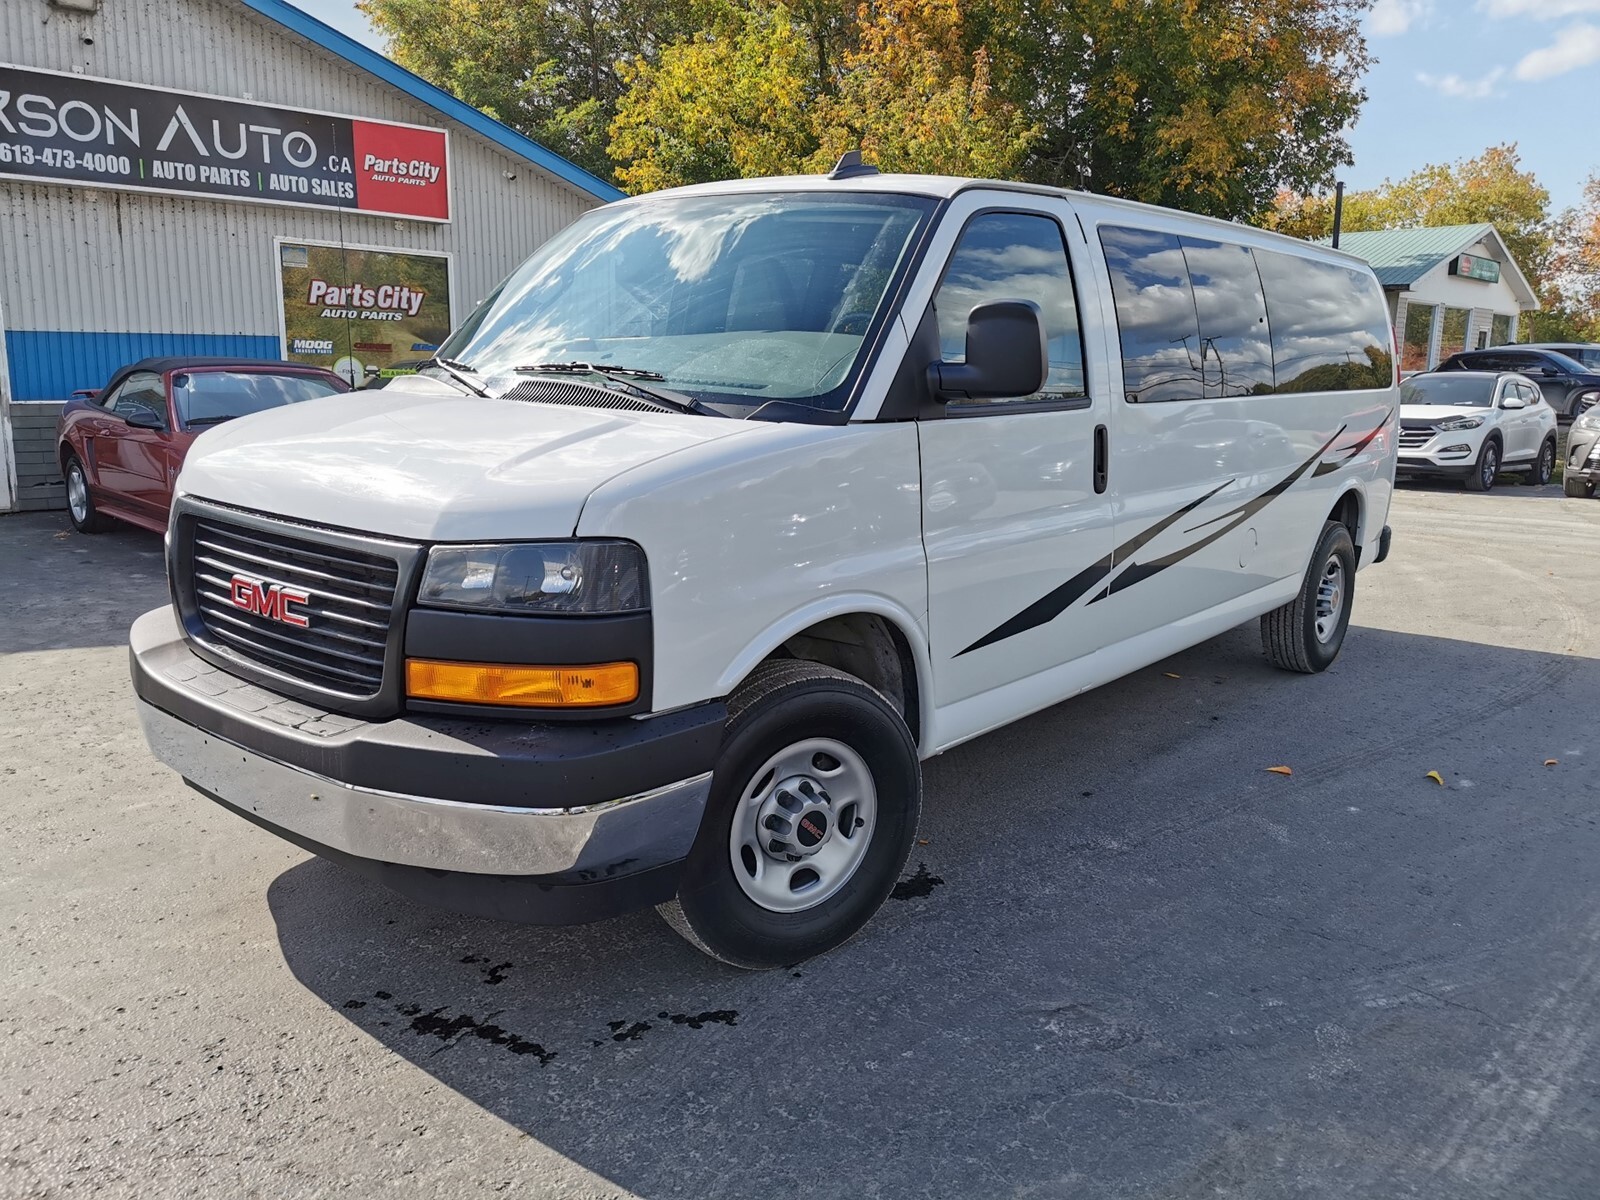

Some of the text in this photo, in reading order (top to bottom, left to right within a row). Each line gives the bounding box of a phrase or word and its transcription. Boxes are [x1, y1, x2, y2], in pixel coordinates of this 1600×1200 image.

[156, 103, 317, 168] AUTO
[0, 142, 131, 175] 613-473-4000
[153, 160, 250, 188] AUTO PARTS
[269, 173, 354, 199] AUTO SALES
[371, 174, 427, 187] AUTO PARTS
[321, 308, 403, 321] AUTO PARTS
[294, 339, 333, 349] MOOG
[231, 573, 310, 628] GMC
[800, 818, 823, 840] GMC
